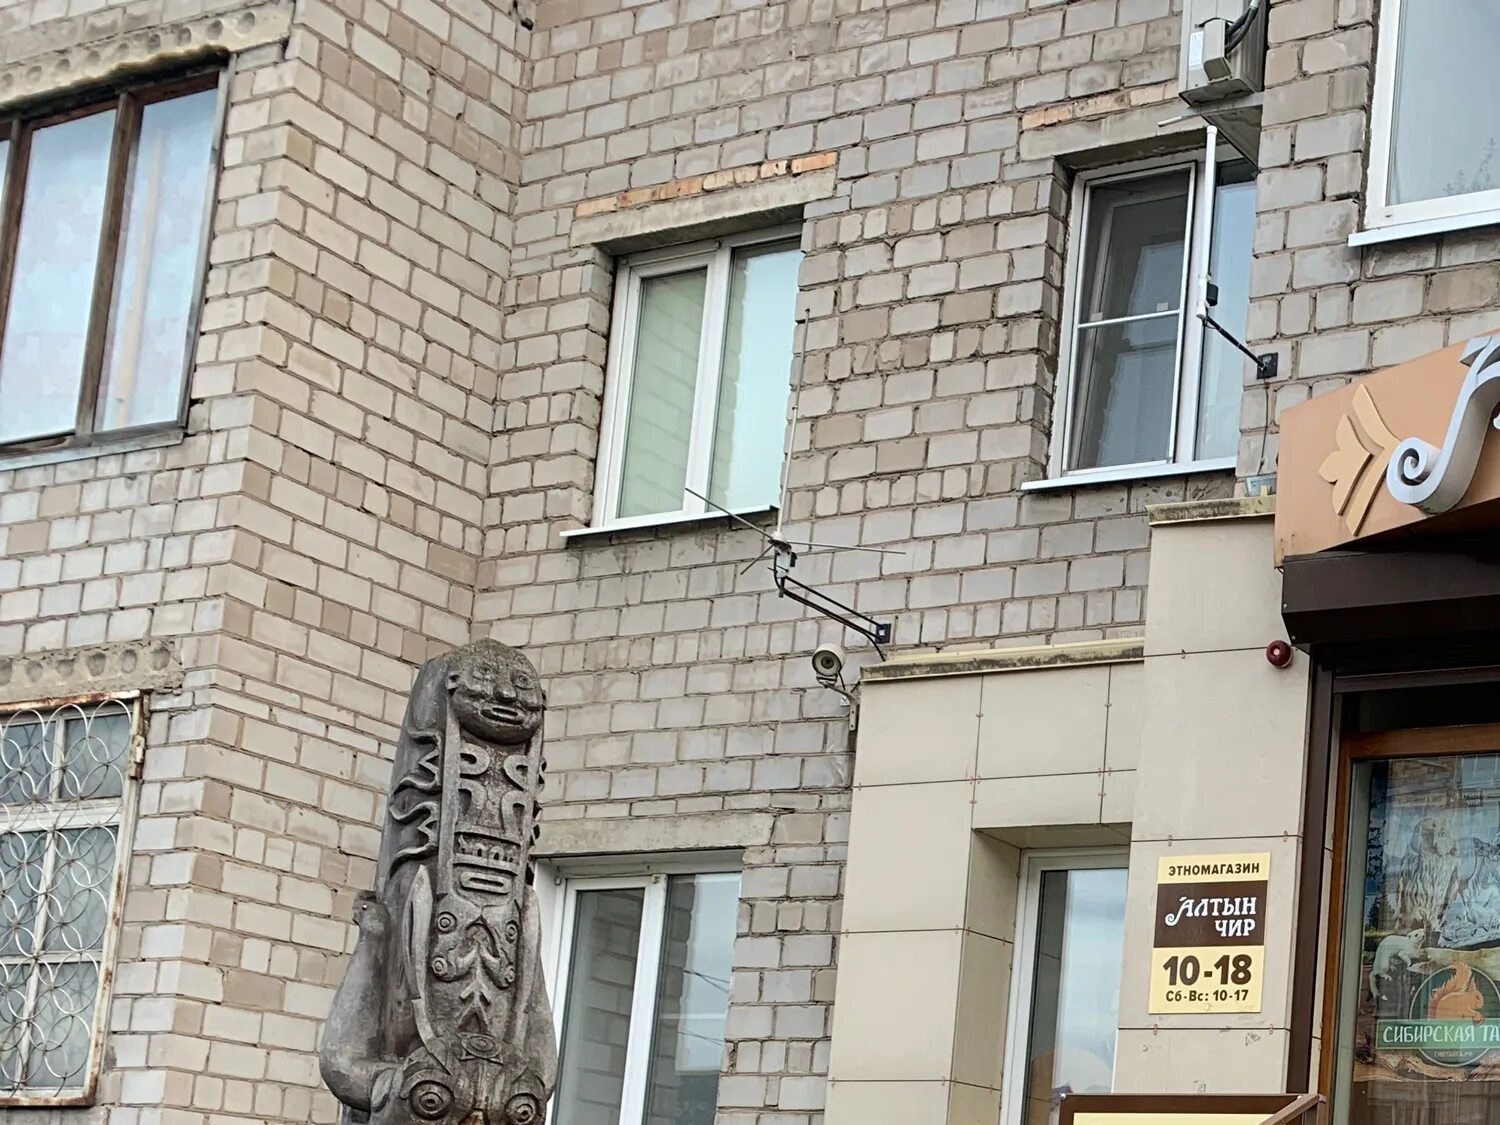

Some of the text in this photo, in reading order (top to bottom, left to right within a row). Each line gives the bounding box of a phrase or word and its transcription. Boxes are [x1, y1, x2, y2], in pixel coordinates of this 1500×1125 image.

[1168, 862, 1261, 877] ЭТНОМАГАЗИН
[1164, 896, 1257, 927] АЛТЫН
[1215, 918, 1256, 937] ЧИР
[1383, 1025, 1475, 1043] СИБИРСКАЯ
